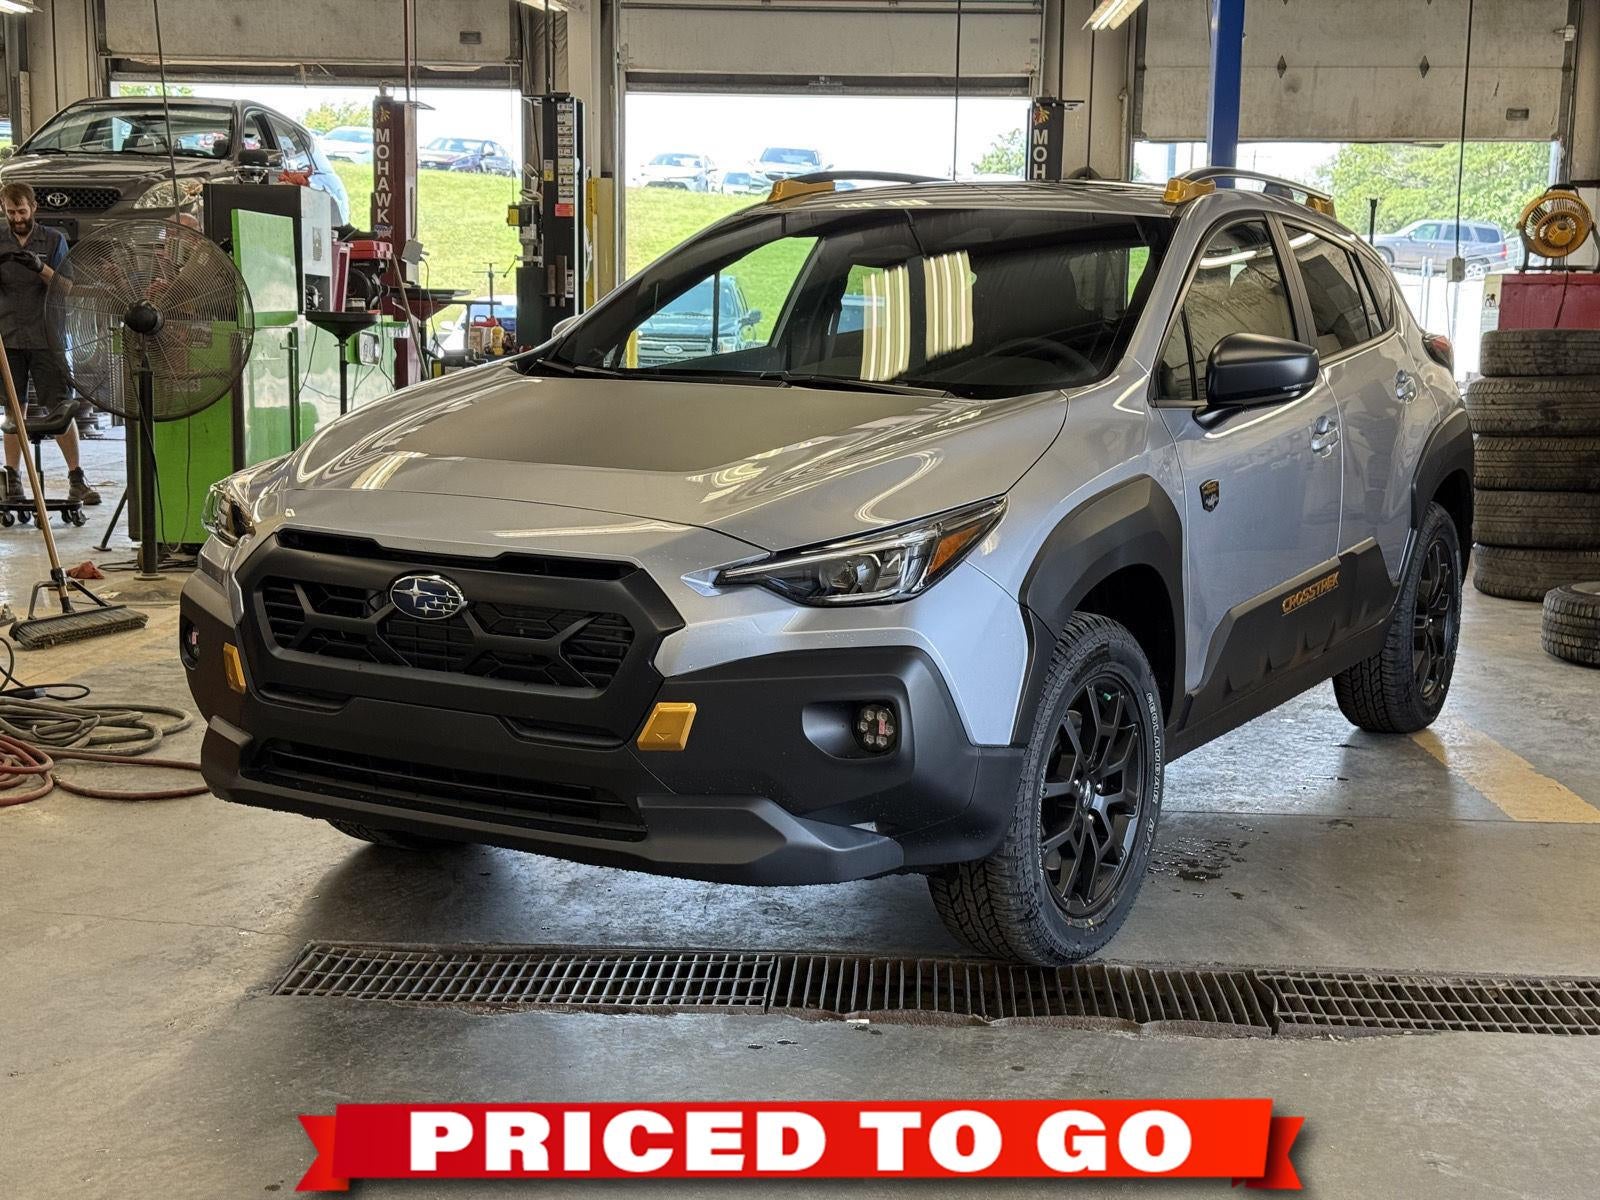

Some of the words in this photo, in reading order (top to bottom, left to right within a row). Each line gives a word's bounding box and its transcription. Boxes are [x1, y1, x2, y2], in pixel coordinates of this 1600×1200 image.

[374, 127, 393, 224] MOHAWK
[1282, 571, 1340, 614] CROSSTREK
[1146, 692, 1162, 805] GEOLANDAR
